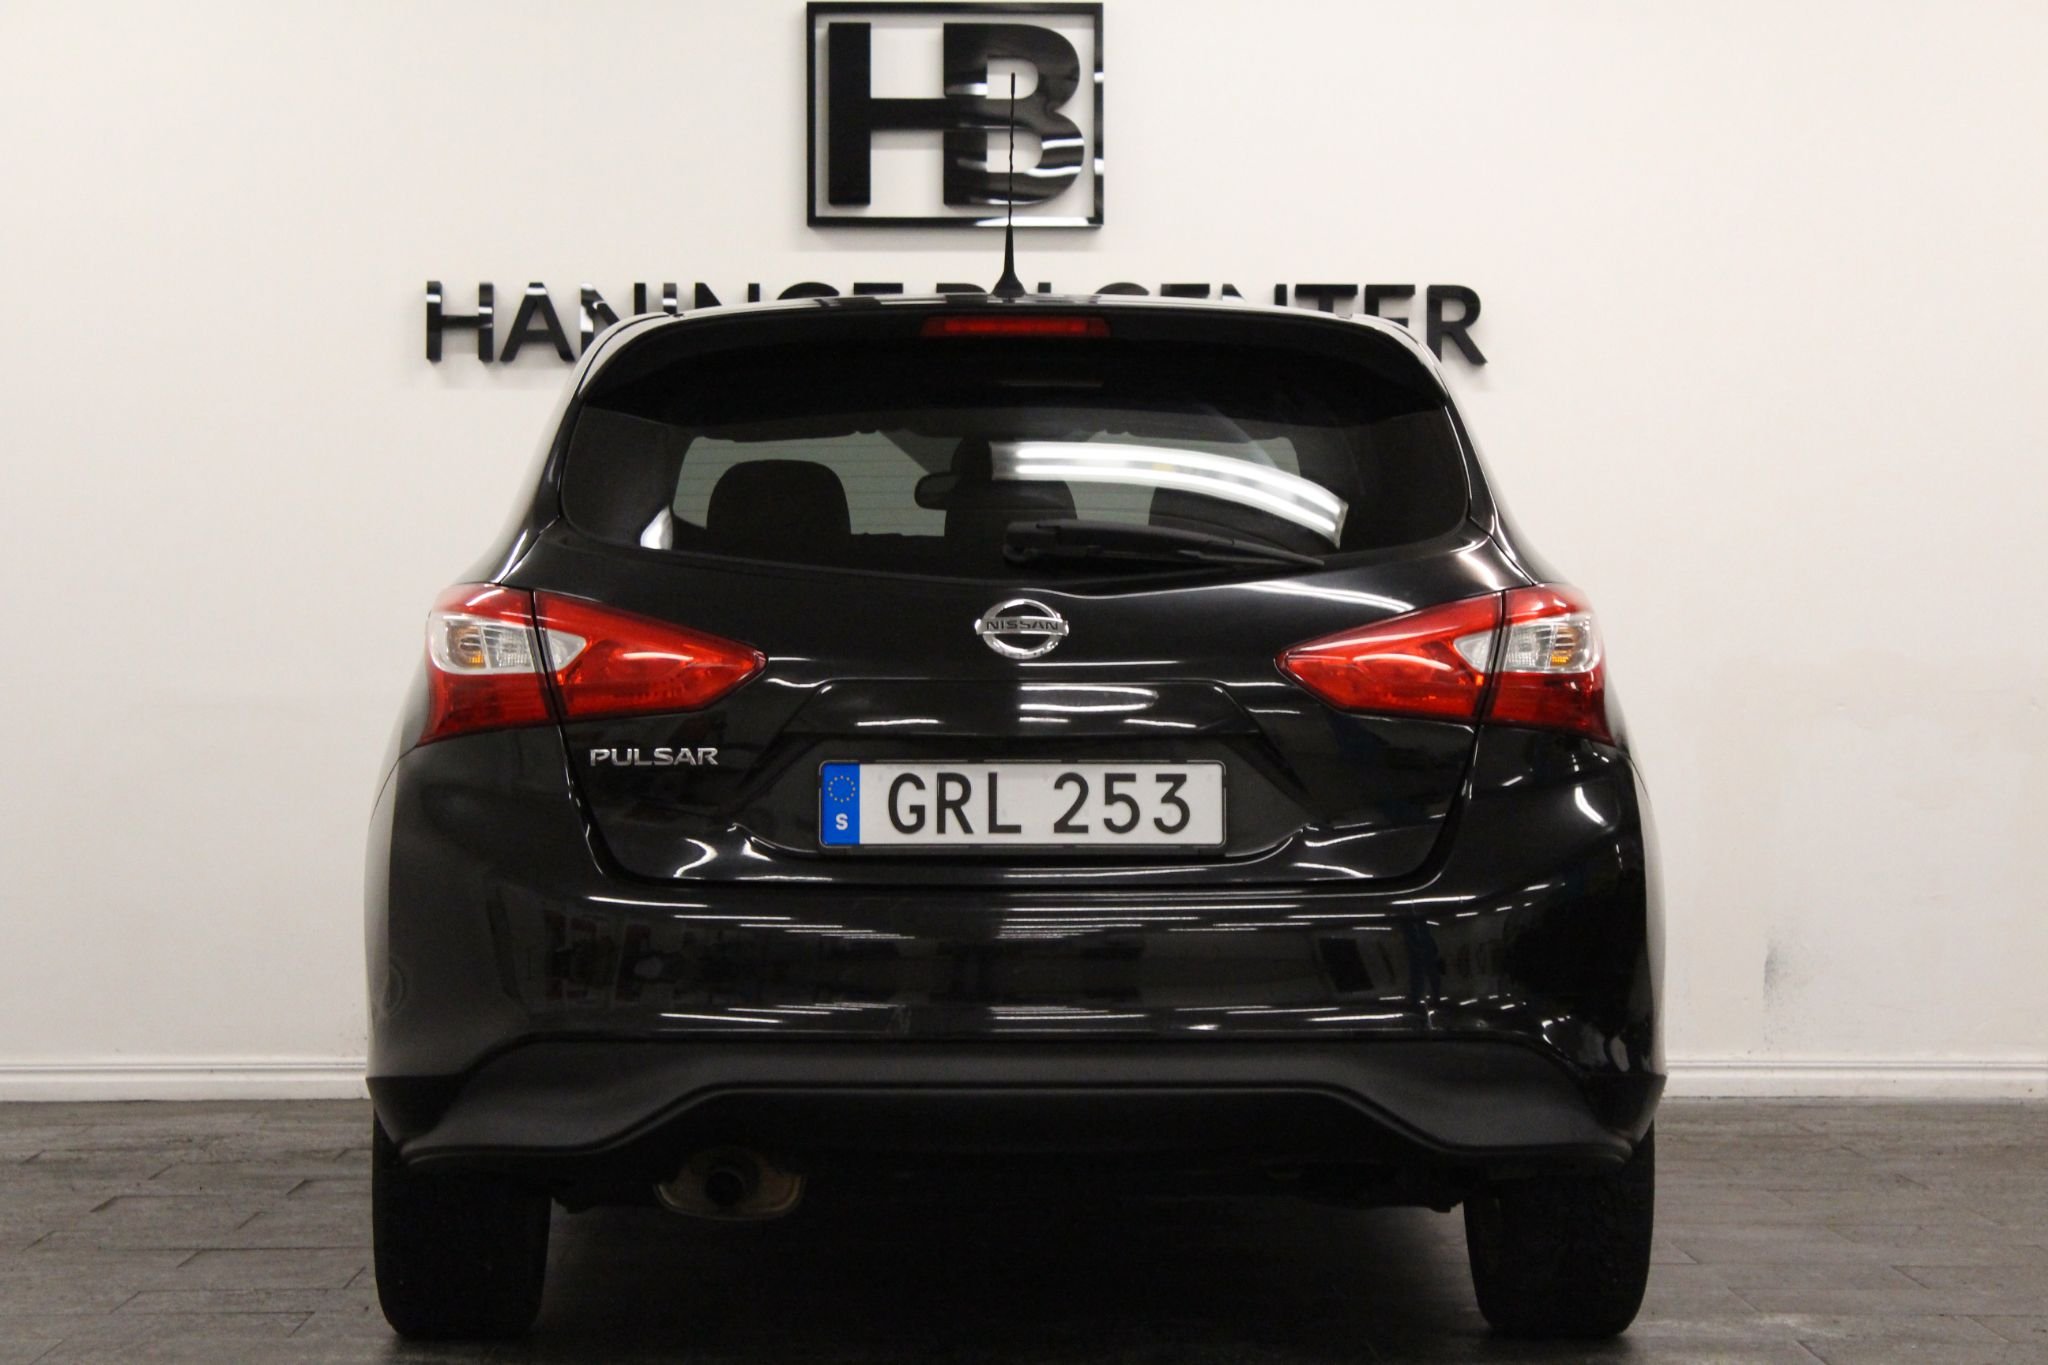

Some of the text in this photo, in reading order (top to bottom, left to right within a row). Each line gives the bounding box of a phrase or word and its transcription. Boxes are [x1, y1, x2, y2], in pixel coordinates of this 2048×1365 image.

[828, 22, 1084, 206] HB
[985, 620, 1059, 632] NISSAN
[589, 747, 719, 766] PULSAR
[887, 772, 1191, 834] GRL 253
[835, 813, 848, 830] S
